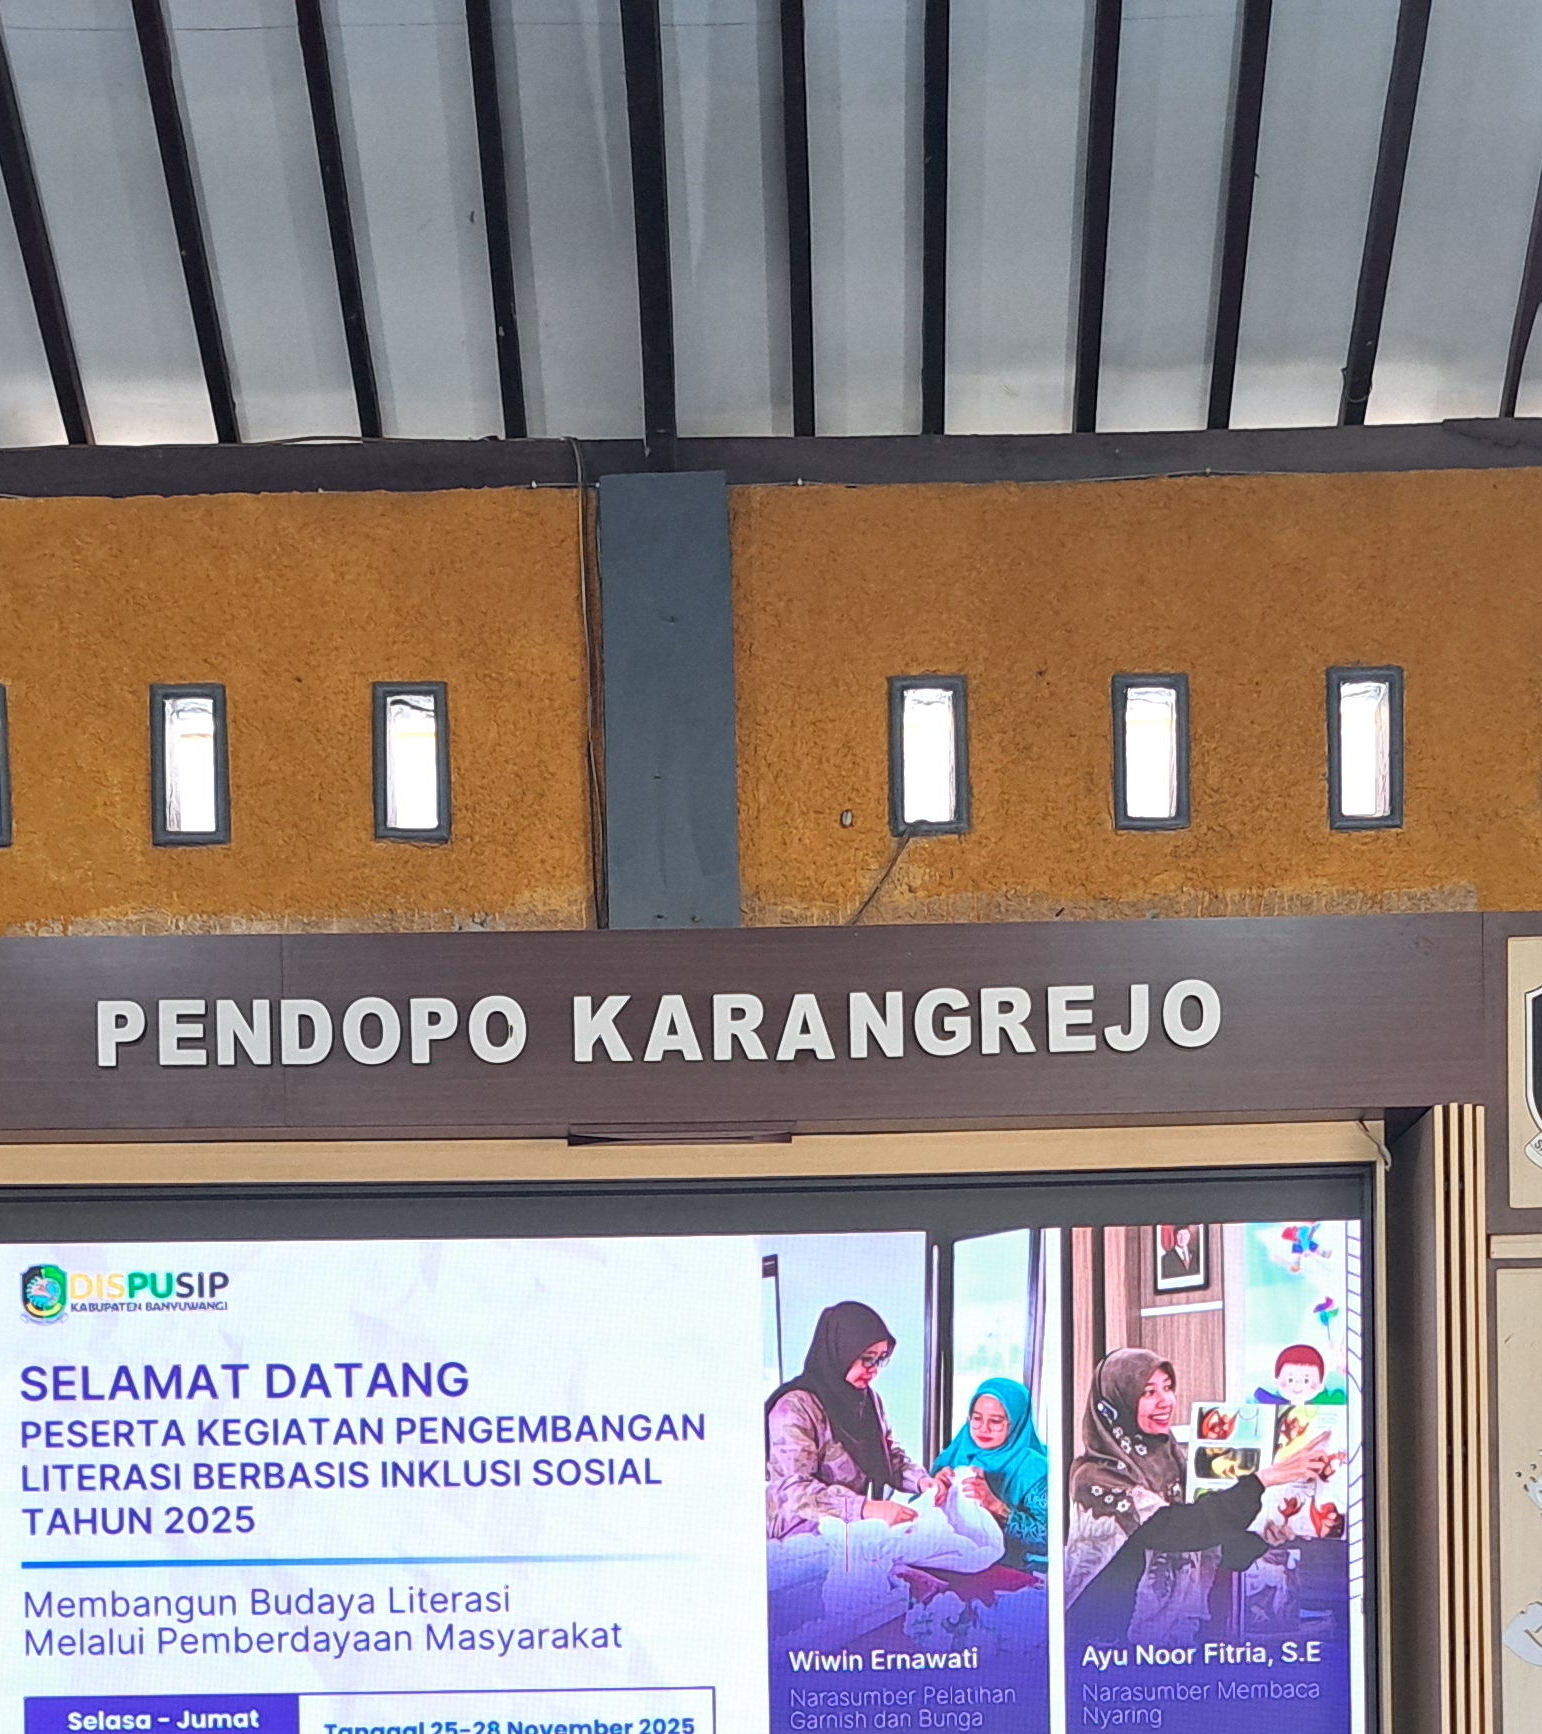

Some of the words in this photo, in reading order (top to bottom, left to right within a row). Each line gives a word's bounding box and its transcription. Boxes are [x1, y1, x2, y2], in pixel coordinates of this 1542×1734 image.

[96, 995, 528, 1067] PENDOPO
[574, 979, 1225, 1063] KARANGREJO
[70, 1271, 230, 1299] DISPUSIP
[71, 1302, 142, 1312] KABUPATEN
[145, 1301, 228, 1312] BANYUWANGI
[19, 1364, 249, 1403] SELAMAT
[264, 1361, 470, 1399] DATANG
[19, 1419, 188, 1450] PESERTA
[196, 1416, 387, 1447] KEGIATAN
[395, 1412, 706, 1445] PENGEMBANGAN
[21, 1462, 183, 1493] LITERASI
[192, 1459, 370, 1491] BERBASIS
[379, 1459, 522, 1489] INKLUSI
[532, 1457, 663, 1487] SOSIAL
[22, 1507, 153, 1537] TAHUN
[164, 1505, 256, 1535] 2025
[23, 1589, 239, 1628] Membangun
[250, 1588, 377, 1623] Budaya
[387, 1585, 510, 1616] Literasi
[24, 1627, 145, 1657] Melalui
[157, 1623, 413, 1663] Pemberdayaan
[424, 1621, 623, 1656] Masyarakat
[1082, 1644, 1128, 1671] Ayu
[1135, 1643, 1196, 1666] Noor
[1203, 1641, 1275, 1666] Fitria,
[1281, 1641, 1321, 1664] S.E
[789, 1648, 863, 1673] Wiwin
[871, 1646, 978, 1672] Ernawati
[790, 1685, 918, 1708] Narasumber
[923, 1684, 1016, 1704] Pelatihan
[1082, 1679, 1211, 1703] Narasumber
[1217, 1678, 1320, 1700] Membaca
[67, 1710, 152, 1732] Selasa
[176, 1707, 260, 1730] Jumat
[790, 1709, 867, 1731] Garnish
[873, 1708, 912, 1729] dan
[918, 1708, 984, 1732] Bunga
[1083, 1704, 1163, 1730] Nyaring
